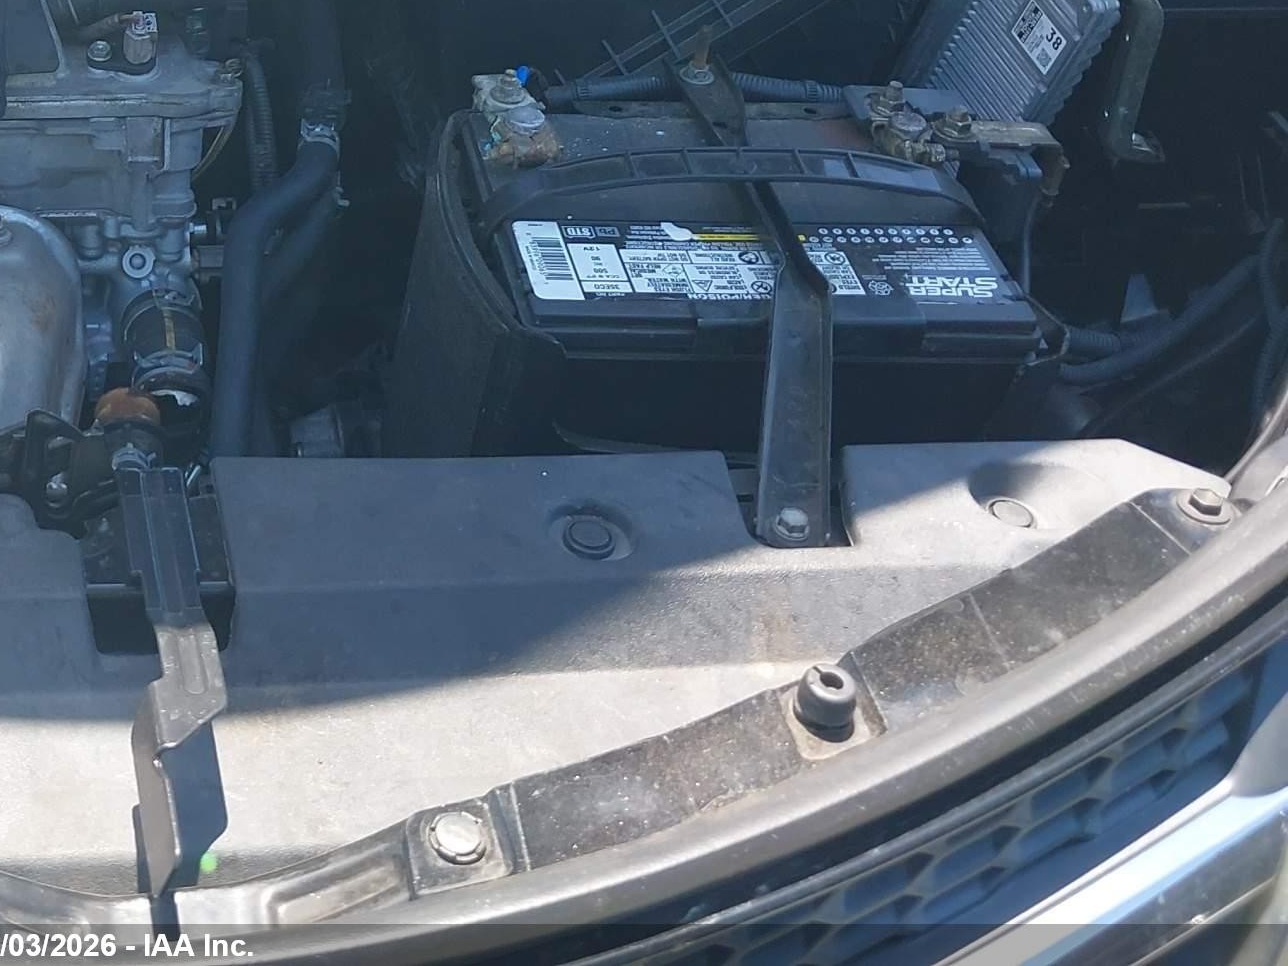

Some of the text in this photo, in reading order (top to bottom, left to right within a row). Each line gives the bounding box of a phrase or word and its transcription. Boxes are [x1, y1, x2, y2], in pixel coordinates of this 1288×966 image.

[1046, 27, 1062, 50] 38
[567, 227, 592, 236] STD
[905, 276, 998, 289] START
[908, 286, 993, 299] SUPER
